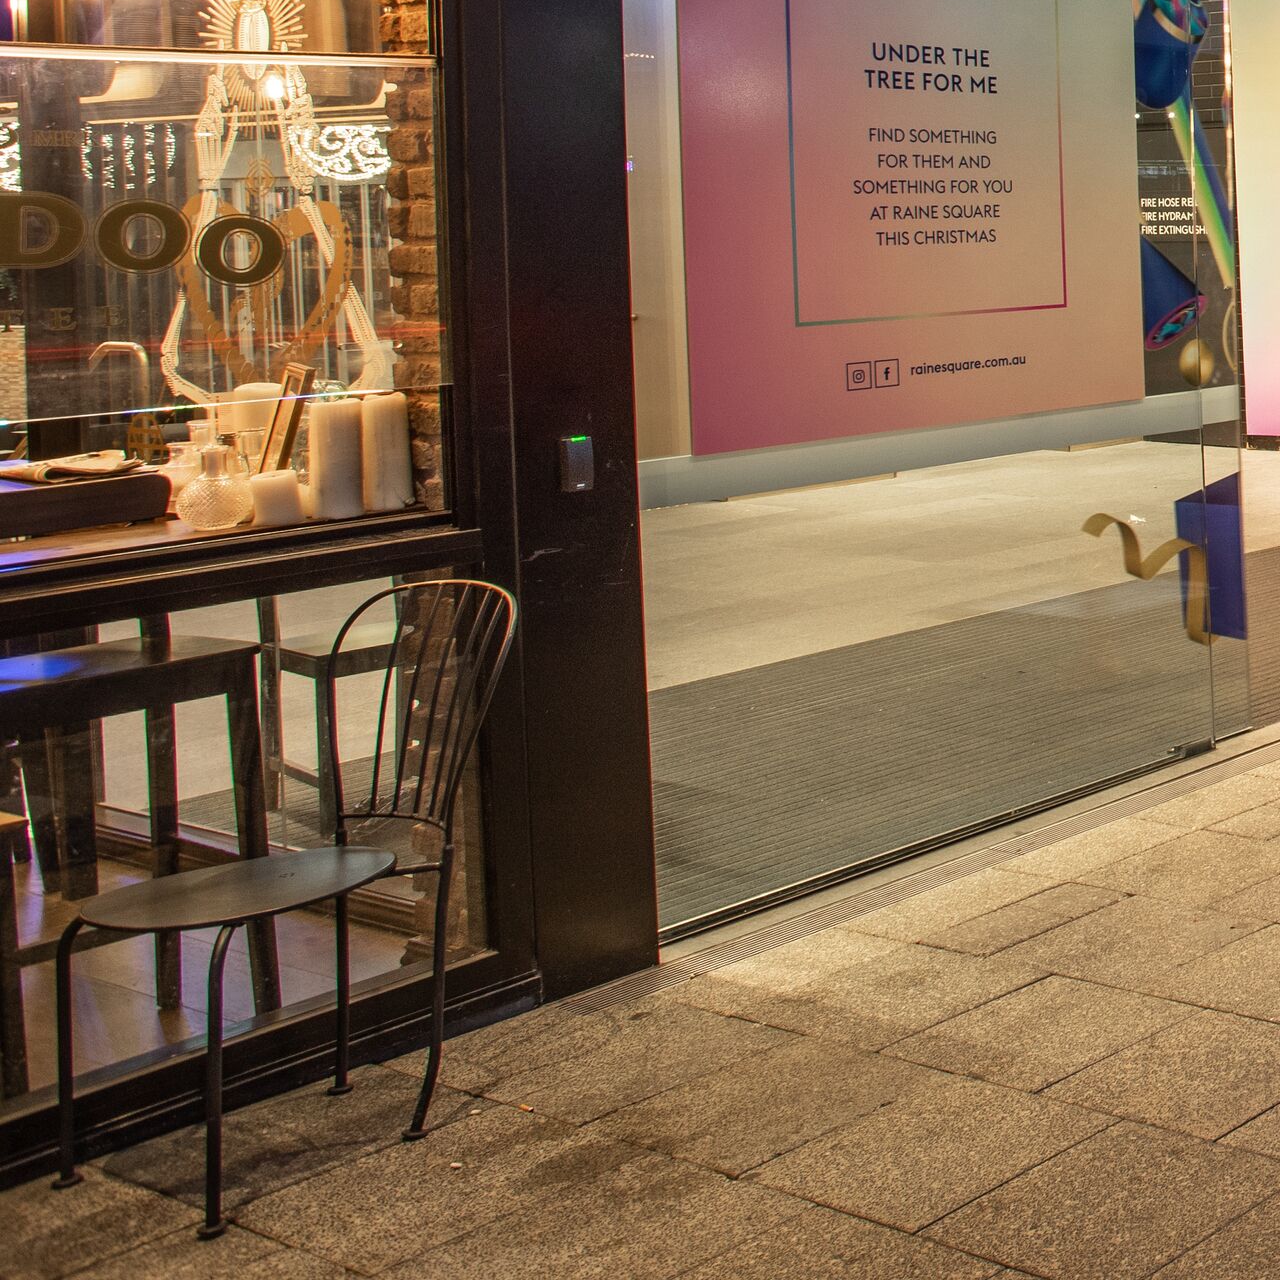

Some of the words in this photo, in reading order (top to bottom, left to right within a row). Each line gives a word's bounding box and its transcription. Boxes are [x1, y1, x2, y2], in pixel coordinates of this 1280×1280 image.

[872, 42, 946, 65] UNDER
[952, 48, 990, 68] THE
[864, 69, 915, 90] TREE
[923, 72, 963, 93] FOR
[970, 76, 998, 94] ME
[869, 127, 905, 143] FIND
[909, 128, 997, 145] SOMETHING
[877, 154, 909, 169] FOR
[912, 154, 954, 169] THEM
[958, 155, 992, 169] AND
[853, 179, 946, 195] SOMETHING
[950, 179, 980, 194] FOR
[982, 179, 1013, 194] YOU
[1140, 198, 1157, 208] FIRE
[1158, 197, 1180, 208] HOSE
[870, 205, 889, 220] AT
[893, 205, 939, 220] RAINE
[943, 204, 1001, 219] SQUARE
[1158, 211, 1197, 221] HYDRAN
[876, 231, 910, 246] THIS
[914, 229, 997, 246] CHRISTMAS
[1141, 225, 1157, 235] FIRE
[910, 354, 1027, 376] rainesquare.com.au
